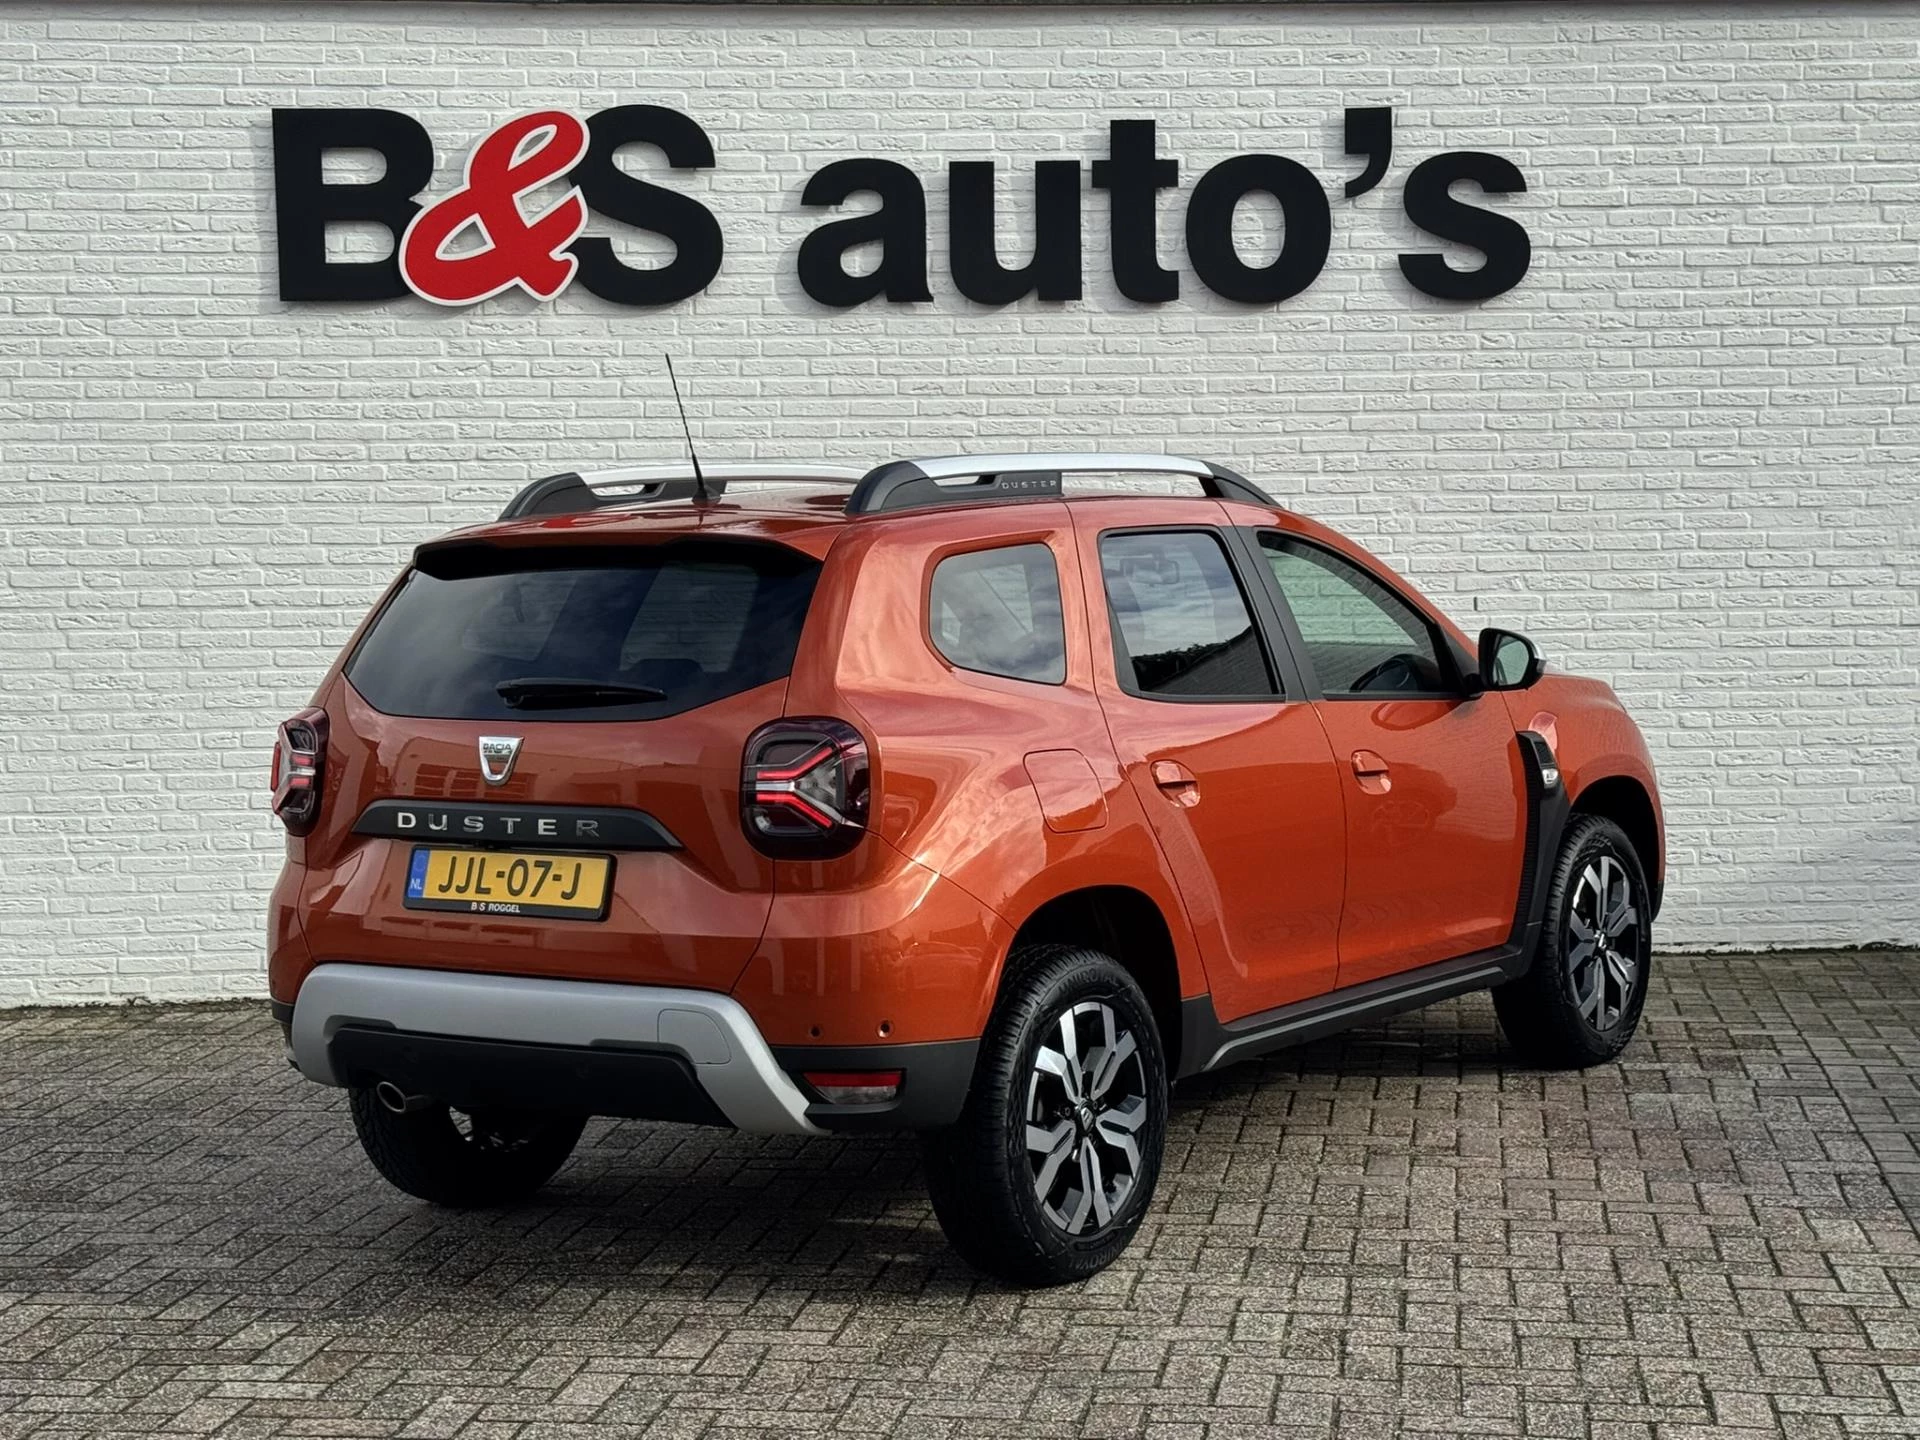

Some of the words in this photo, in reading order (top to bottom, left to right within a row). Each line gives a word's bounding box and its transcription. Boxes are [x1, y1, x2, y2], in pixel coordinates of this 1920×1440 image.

[272, 104, 723, 306] B&S
[798, 107, 1532, 305] auto's
[1001, 480, 1057, 489] DUSTER
[397, 812, 600, 837] DUSTER
[410, 878, 423, 890] NL
[438, 856, 582, 900] JJL-07-J
[471, 901, 478, 911] B
[479, 902, 486, 912] S
[488, 903, 521, 913] ROGGEL
